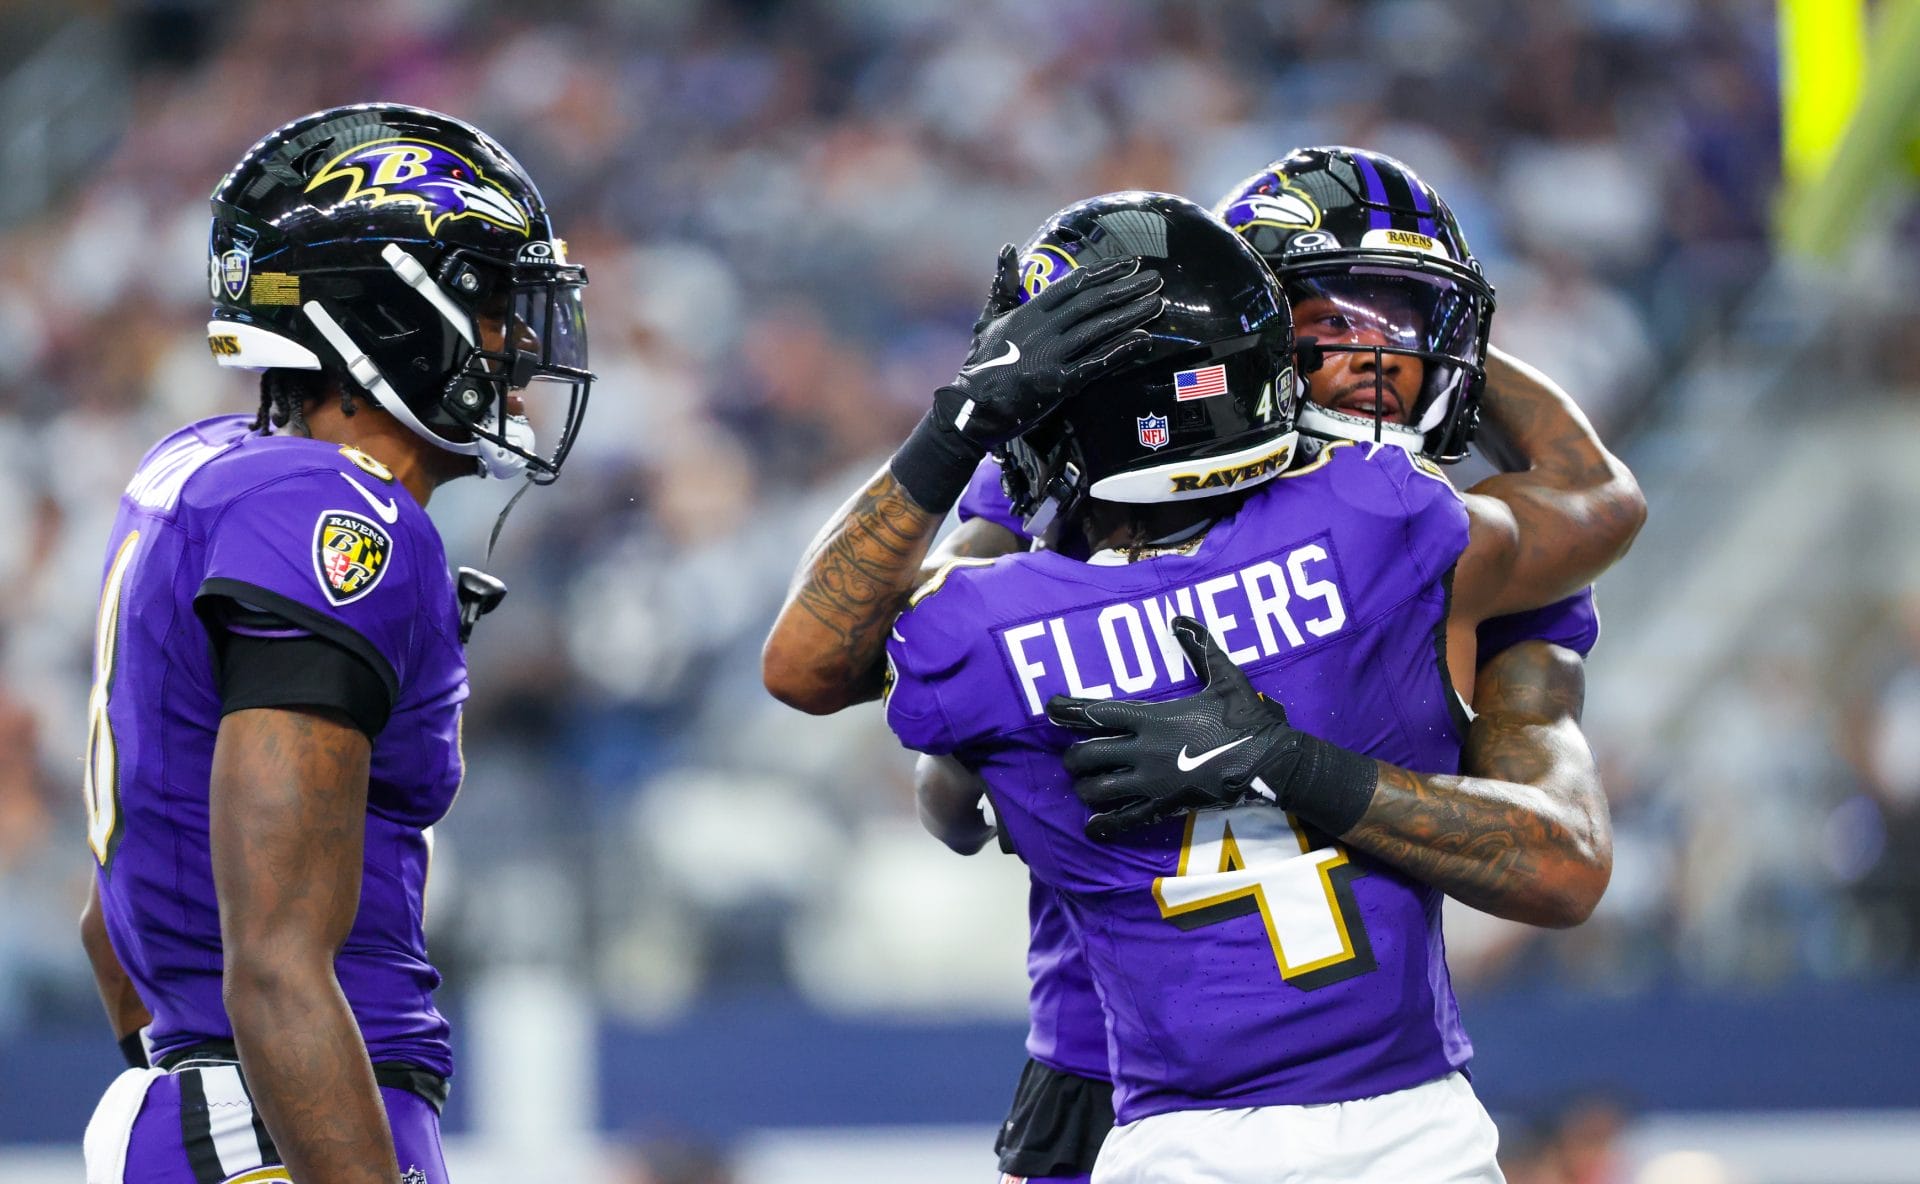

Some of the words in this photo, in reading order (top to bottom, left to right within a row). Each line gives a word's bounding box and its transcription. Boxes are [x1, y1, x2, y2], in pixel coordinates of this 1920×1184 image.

[1386, 231, 1433, 249] RAVENS
[1255, 381, 1273, 424] 4
[1141, 428, 1165, 444] NFL
[1169, 446, 1290, 493] RAVENS
[329, 516, 386, 548] RAVENS
[1003, 544, 1347, 717] FLOWERS
[1152, 805, 1366, 986] 4
